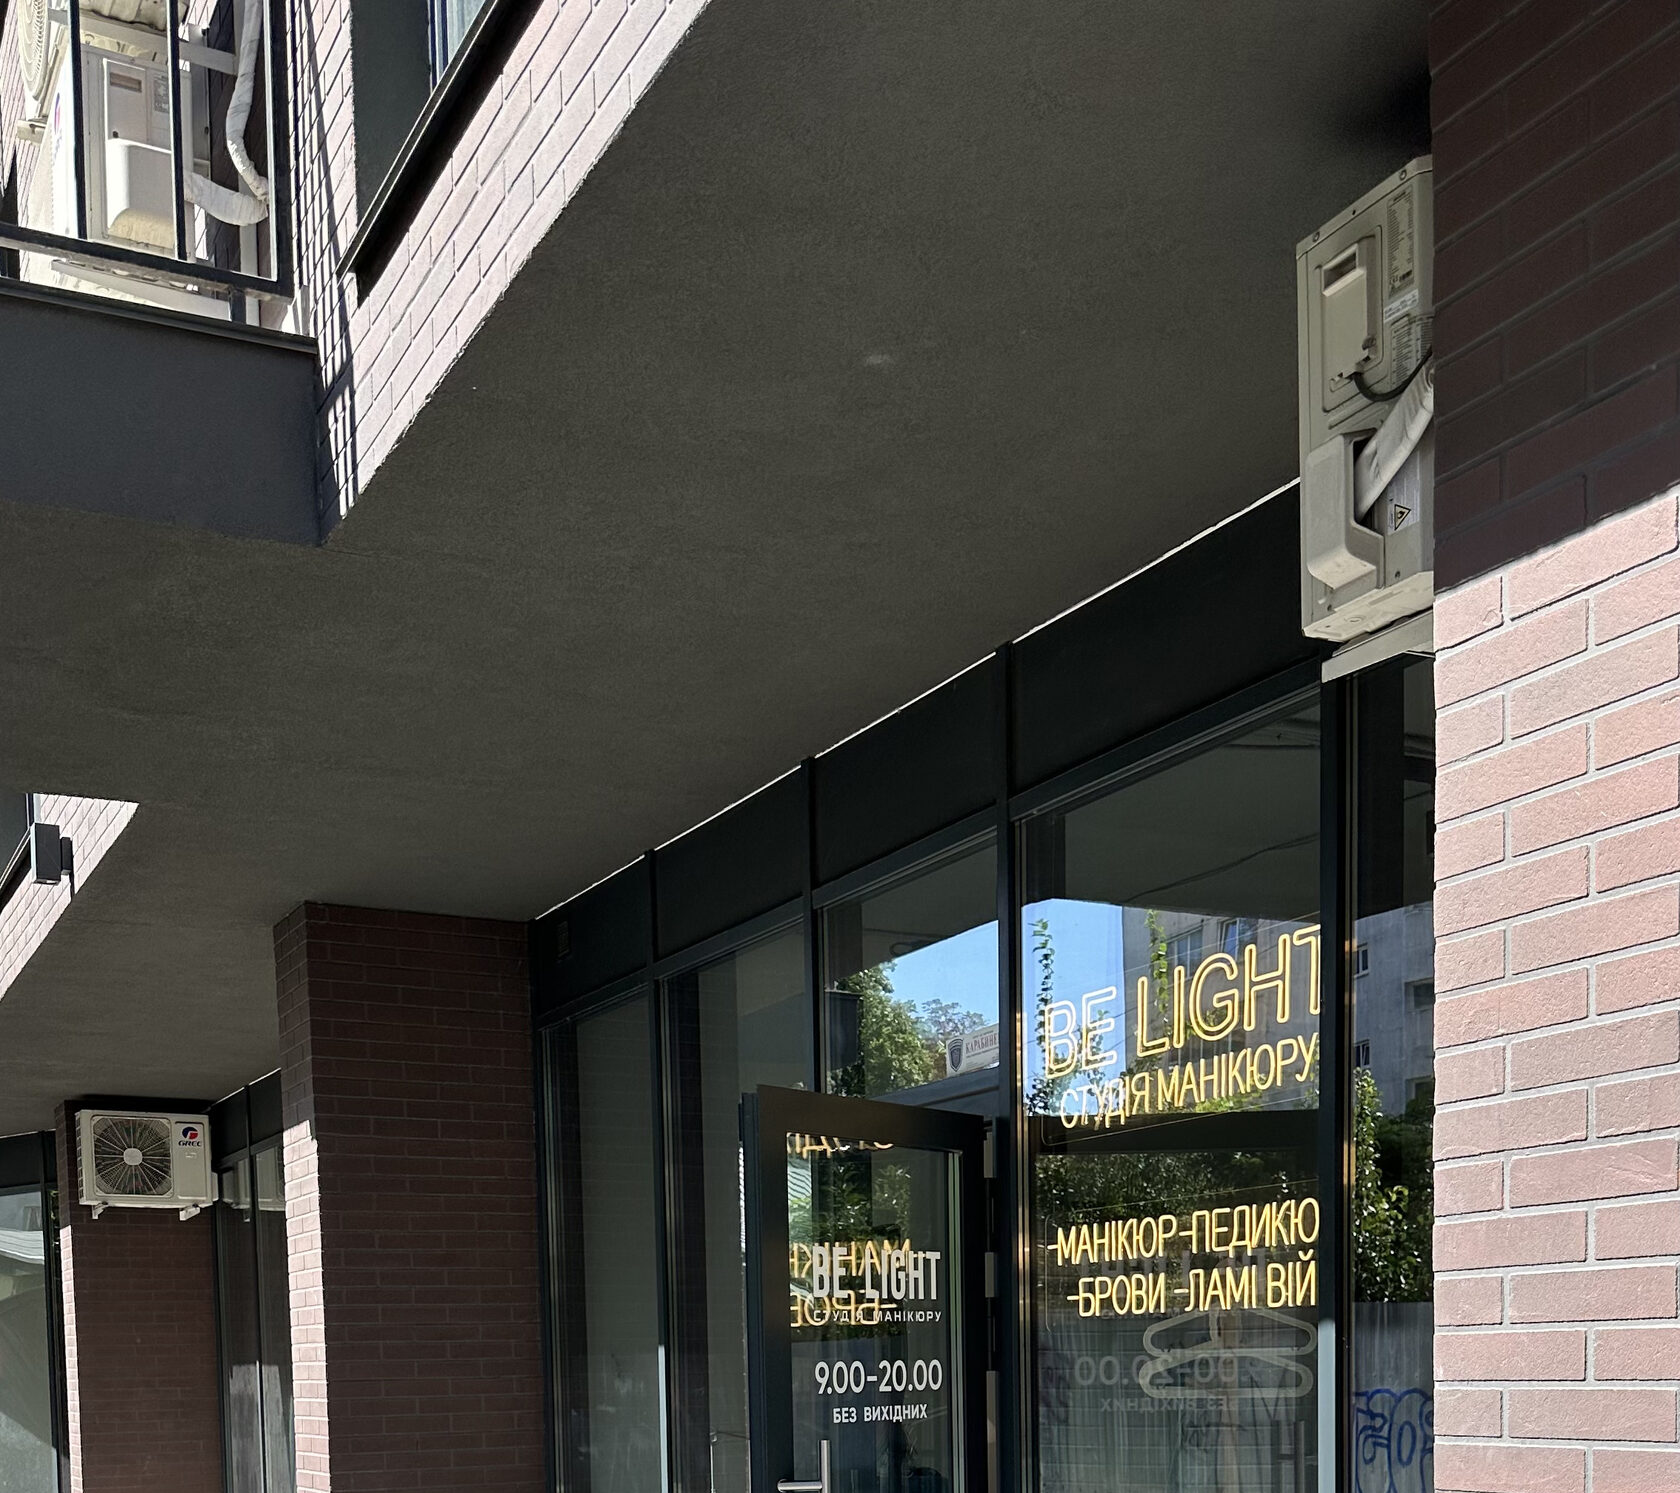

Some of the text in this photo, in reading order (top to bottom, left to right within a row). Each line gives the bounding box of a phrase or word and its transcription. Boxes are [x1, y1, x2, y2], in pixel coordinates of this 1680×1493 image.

[1044, 923, 1320, 1081] BE LIGHT
[965, 1032, 998, 1054] КАРАБИНЕ
[1060, 1031, 1320, 1130] СТУДІЯ МАНІКЮРУ
[812, 1245, 941, 1300] BE LIGHT
[1266, 1249, 1317, 1309] ВІЙ
[813, 1309, 942, 1323] СТУДЯ МАНІКЮРУ
[814, 1358, 943, 1396] 9.00-20.00
[833, 1403, 928, 1424] БЕЗ ВИХІДНИХ
